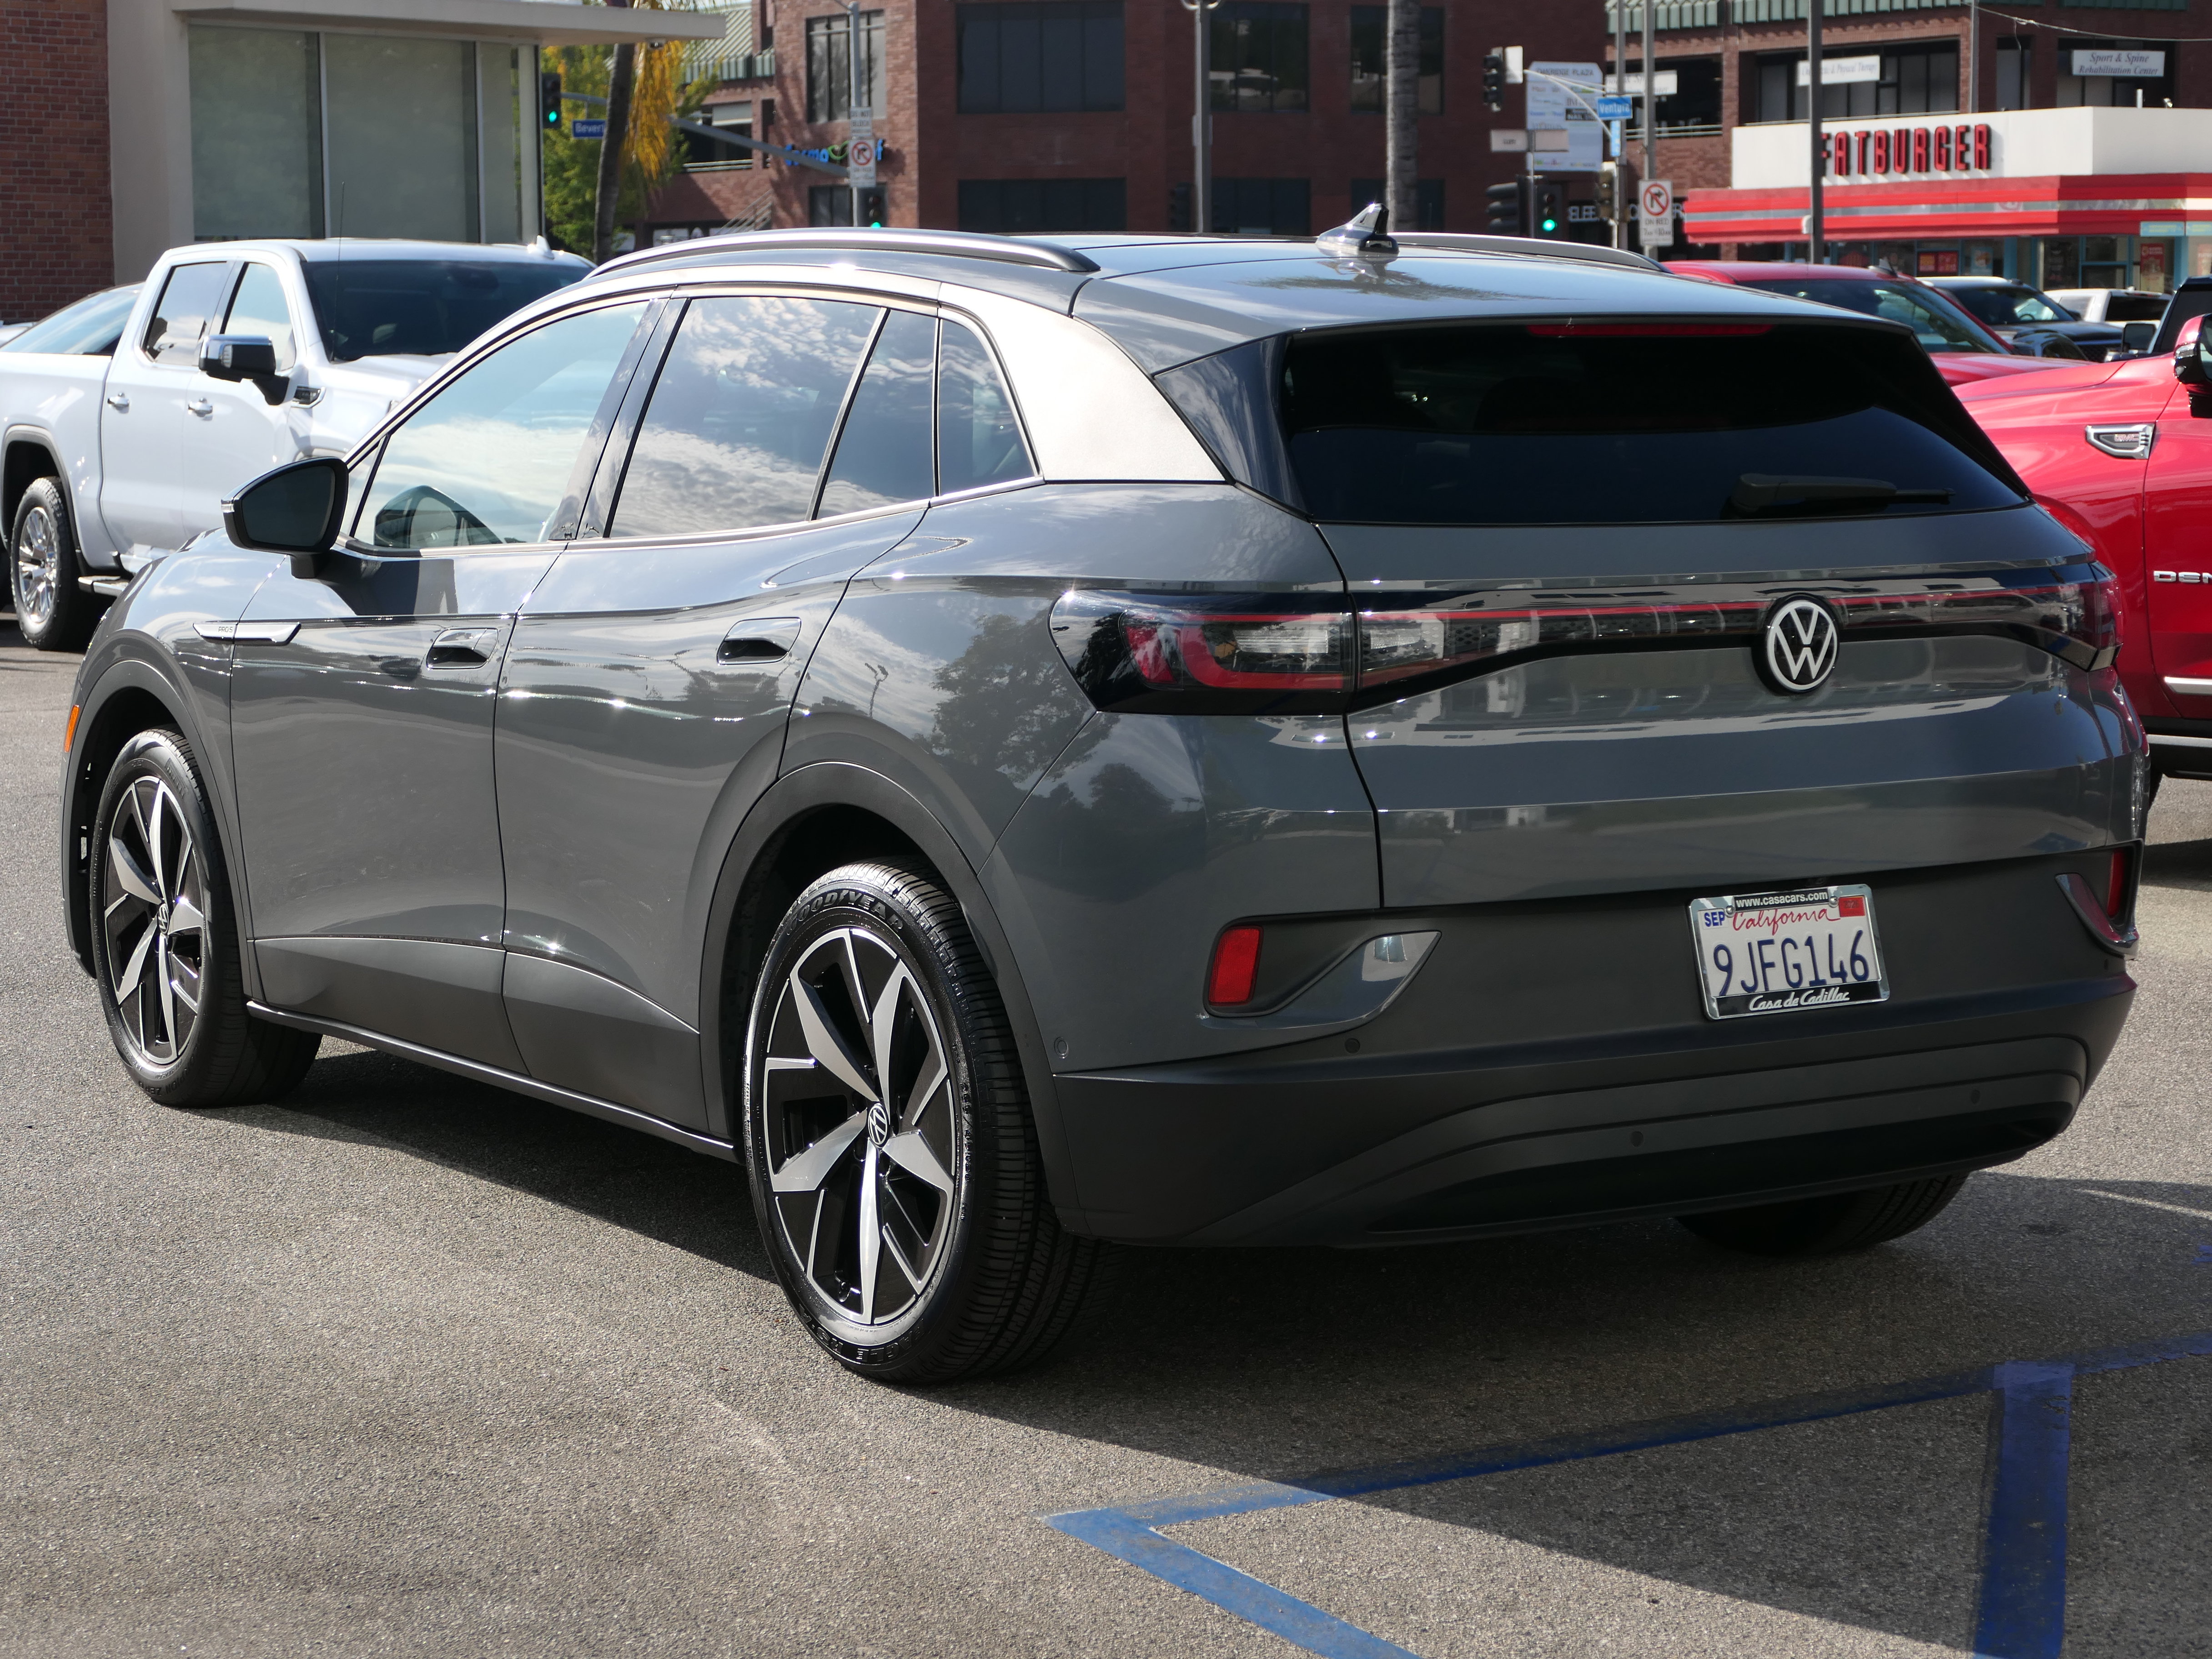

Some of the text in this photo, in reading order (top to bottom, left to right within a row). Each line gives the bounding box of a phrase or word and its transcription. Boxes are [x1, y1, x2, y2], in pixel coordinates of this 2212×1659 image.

[2089, 52, 2150, 65] Sport & Spine
[2079, 65, 2159, 75] Rehabilitation Center
[1599, 102, 1630, 114] Ventura
[1656, 217, 1669, 226] RED
[2115, 433, 2139, 442] GMC
[1735, 891, 1828, 908] www.casacars.com
[1704, 911, 1725, 927] SEP
[1733, 908, 1841, 936] California
[1713, 930, 1869, 996] 9JFG146
[1749, 986, 1851, 1011] Casa de Cadillac
